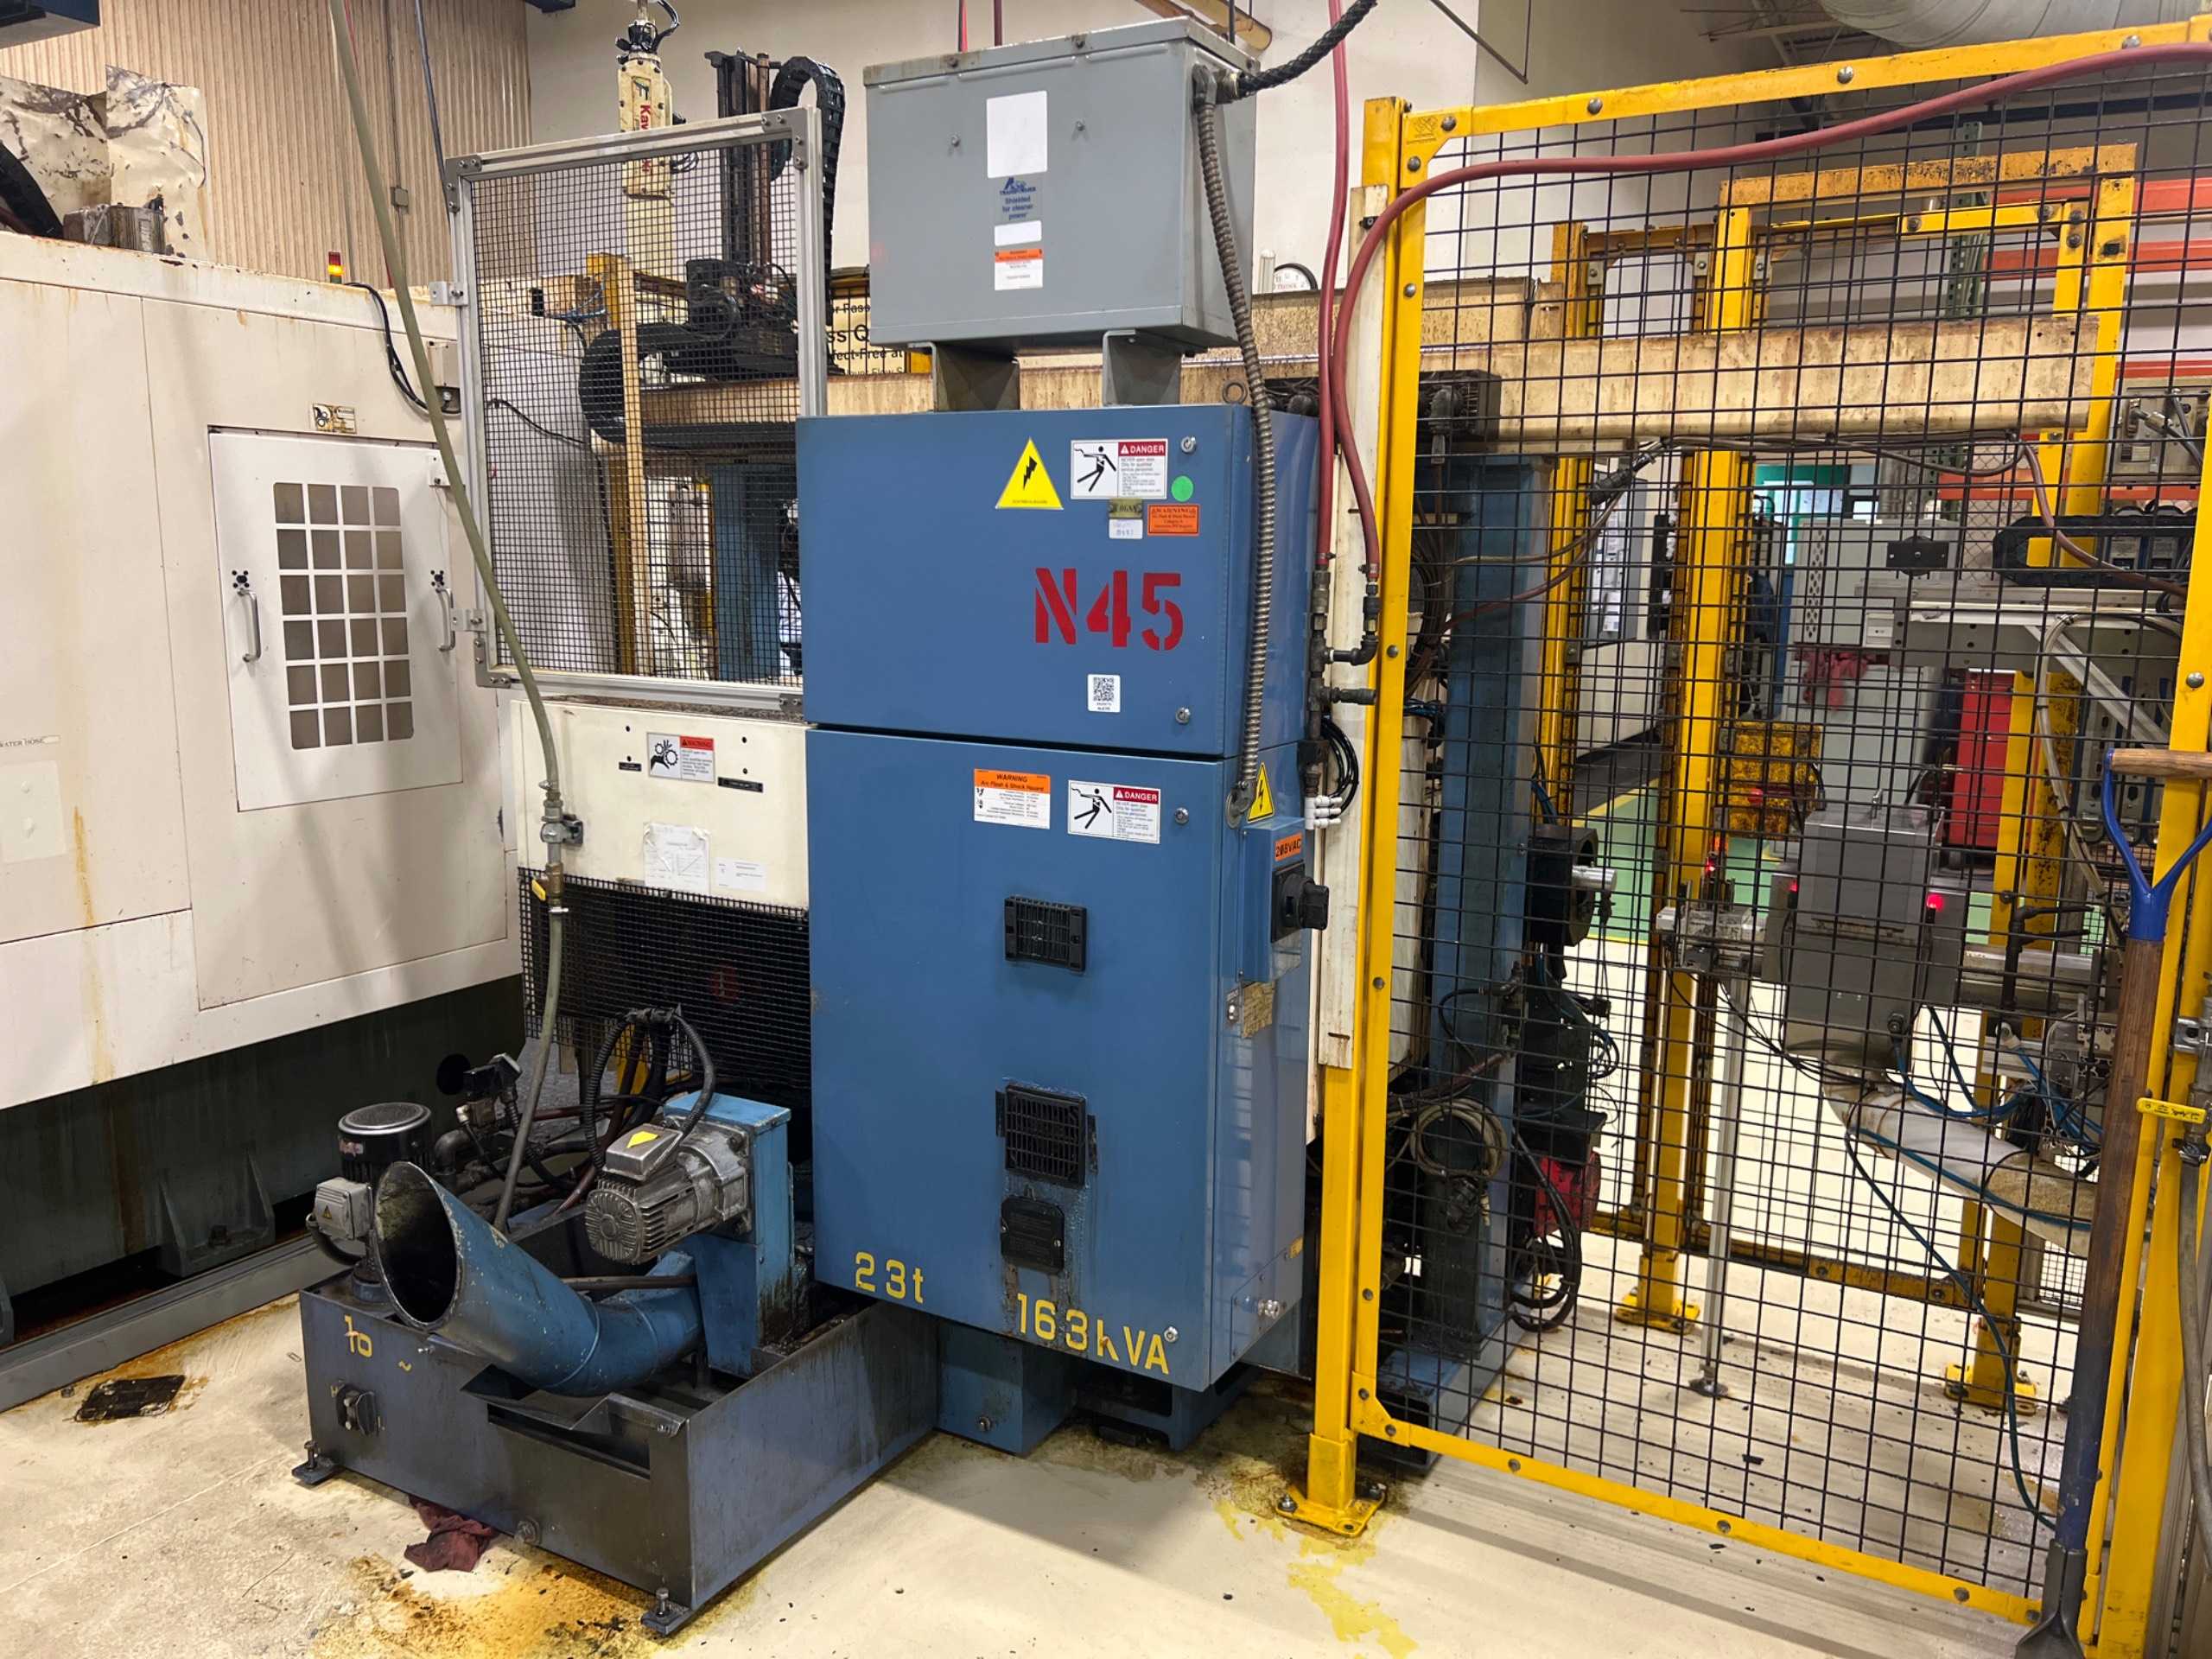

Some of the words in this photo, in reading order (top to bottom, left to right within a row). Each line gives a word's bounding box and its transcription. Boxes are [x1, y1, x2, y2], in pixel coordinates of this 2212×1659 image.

[1129, 444, 1165, 454] DANGER
[1035, 567, 1185, 652] N45
[996, 773, 1028, 783] WARNING
[1124, 791, 1158, 802] DANGER
[1017, 1292, 1170, 1376] 163kVA
